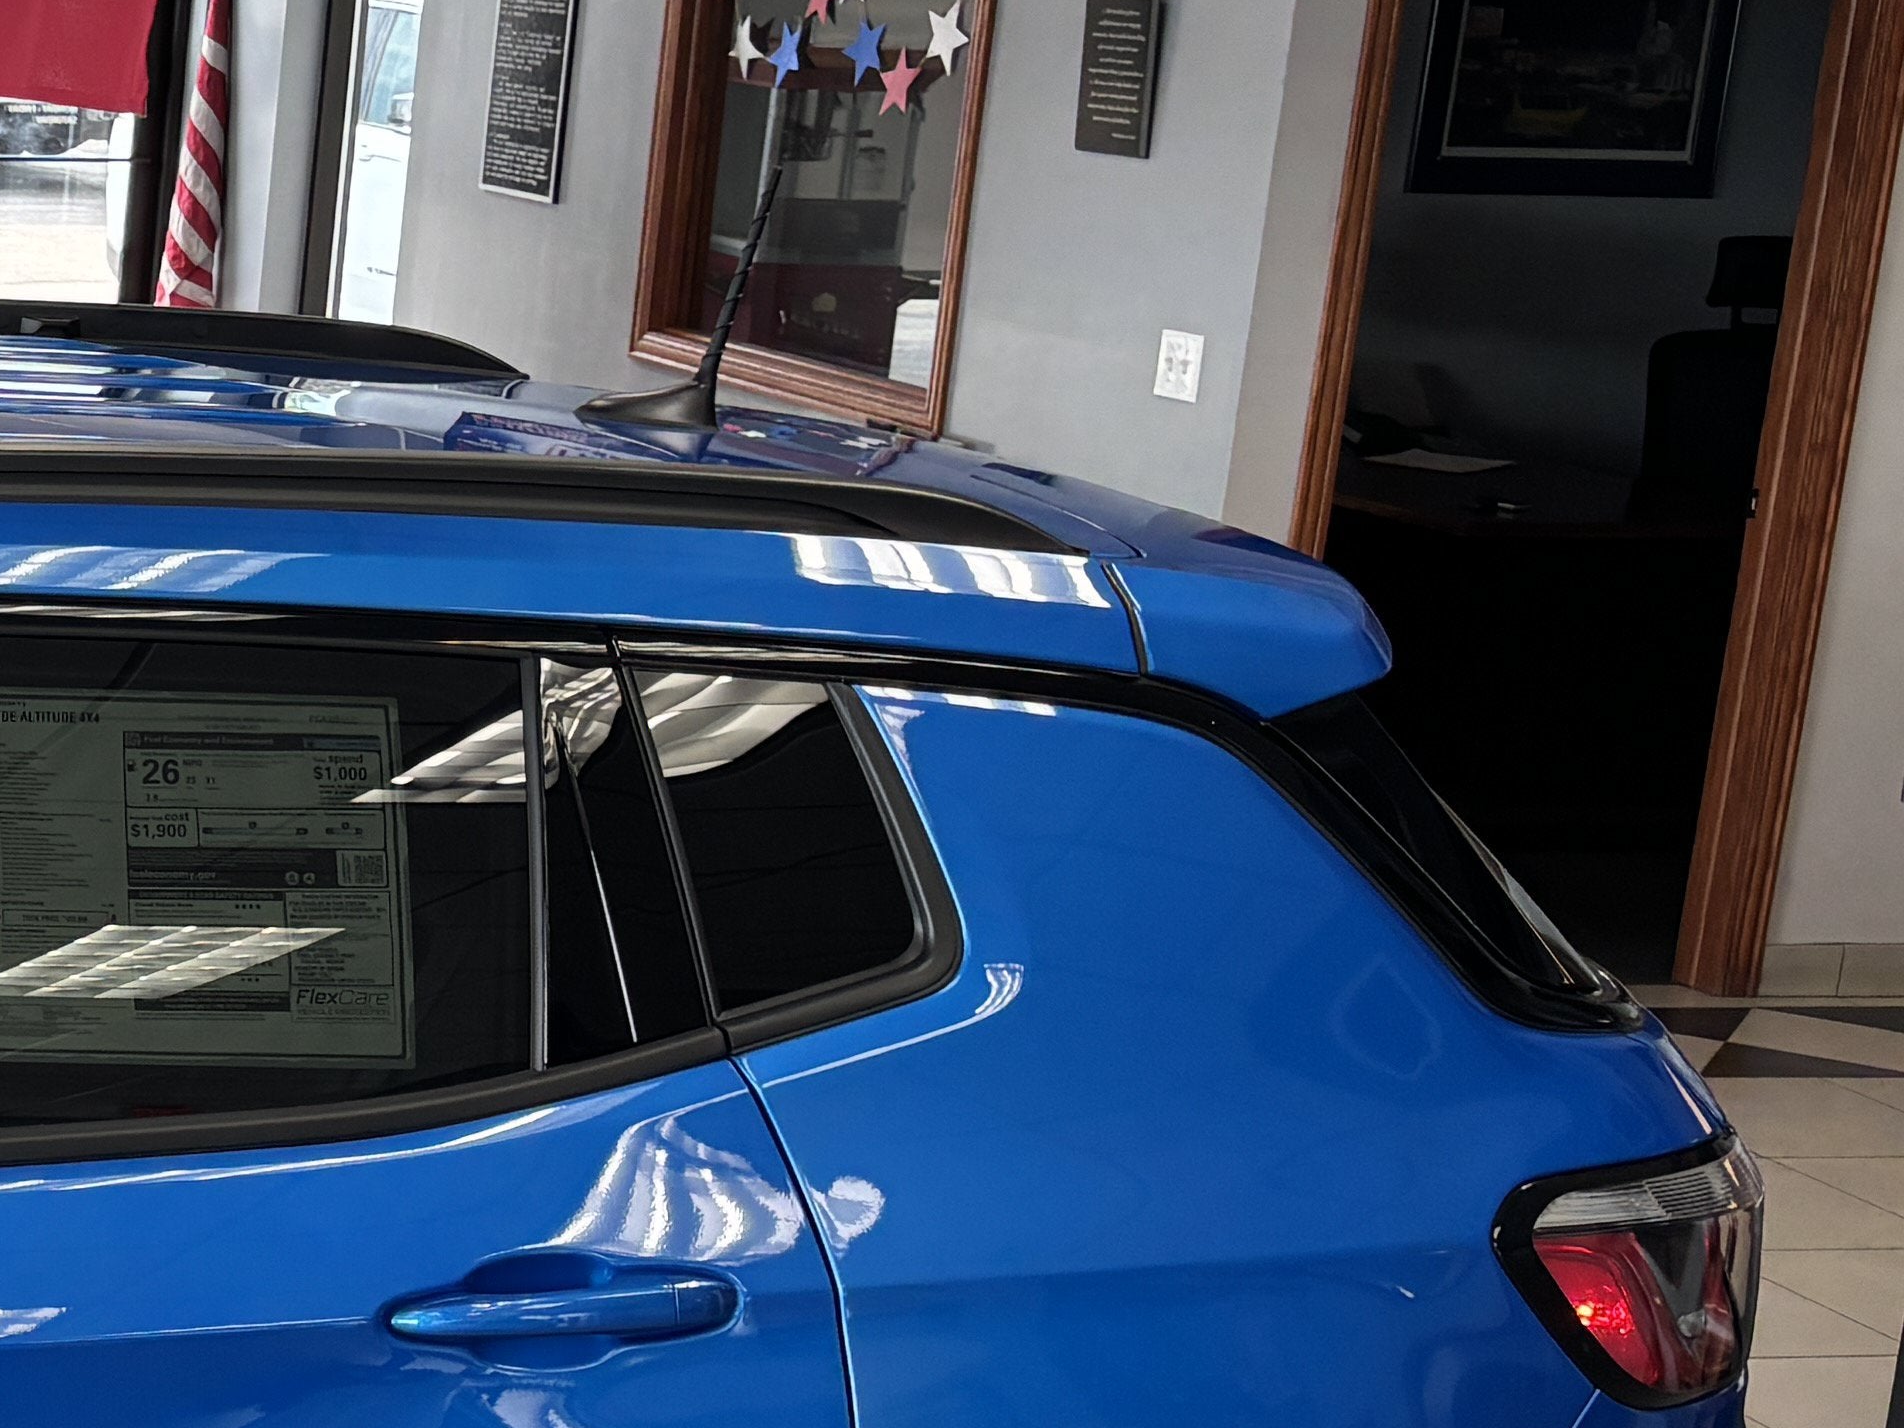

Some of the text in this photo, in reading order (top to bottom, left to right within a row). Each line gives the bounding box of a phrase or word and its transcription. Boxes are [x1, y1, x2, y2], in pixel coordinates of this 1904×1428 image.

[20, 710, 77, 724] ALTITUDE
[142, 758, 180, 785] 26
[313, 766, 367, 782] $1,000
[164, 812, 190, 822] cost
[130, 824, 187, 839] $1,900
[296, 988, 389, 1006] FlexCare
